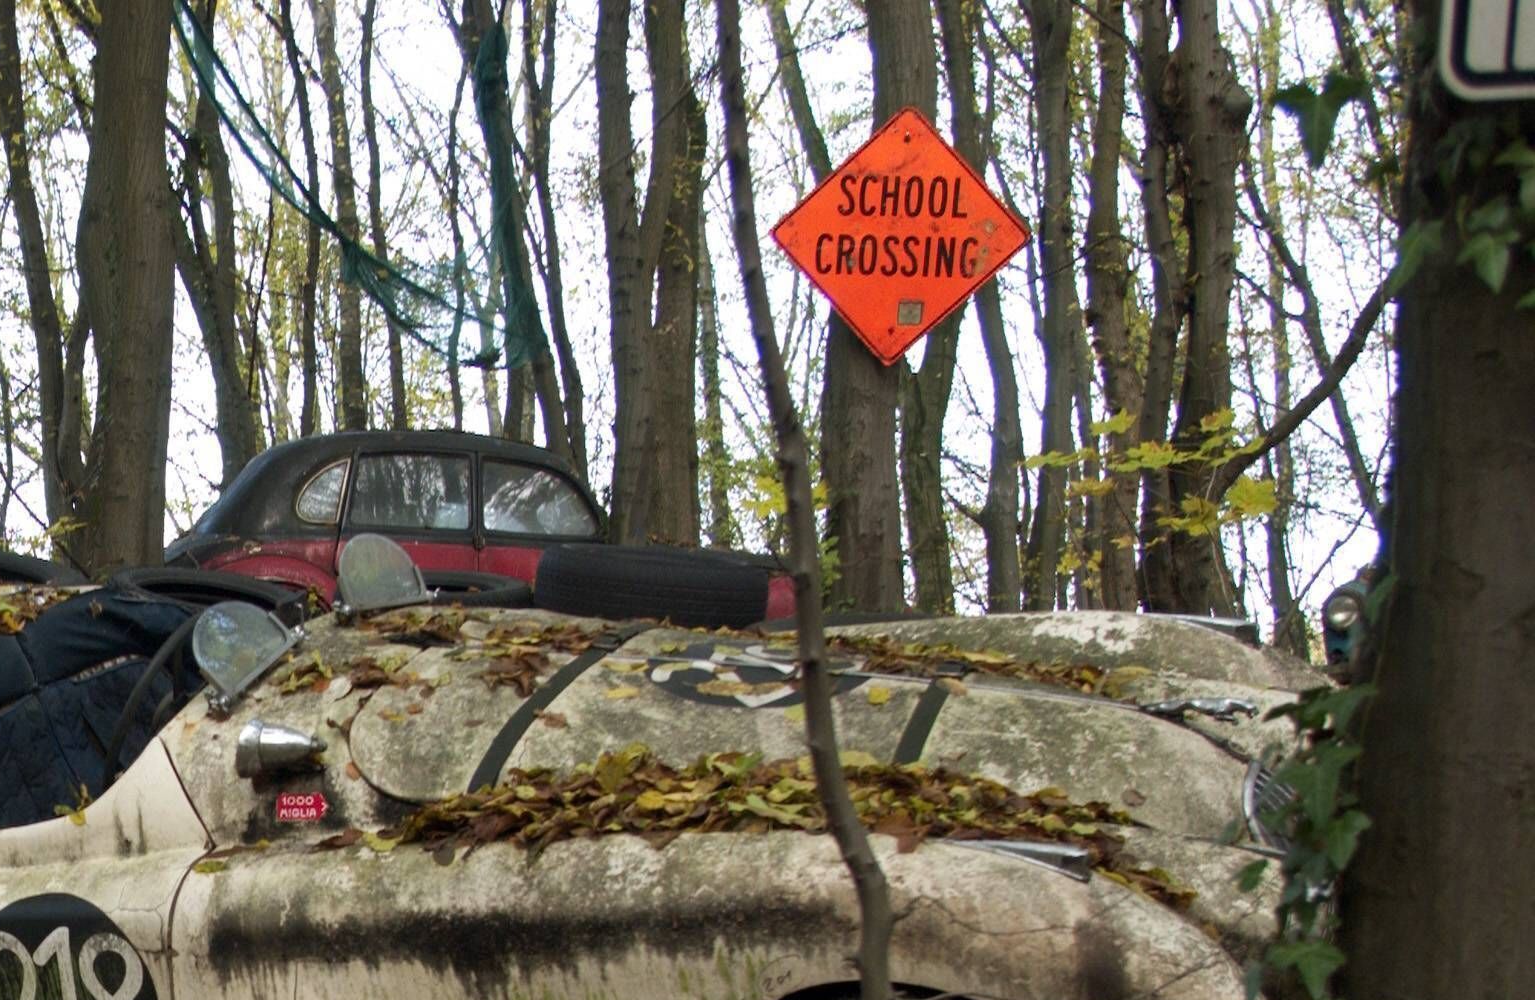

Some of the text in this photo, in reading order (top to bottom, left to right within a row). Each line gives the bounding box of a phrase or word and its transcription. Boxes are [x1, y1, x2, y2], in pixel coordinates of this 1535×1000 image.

[837, 174, 968, 218] SCHOOL
[815, 233, 979, 279] CROSSING
[280, 808, 317, 818] MIGLIA
[282, 796, 314, 806] 1000
